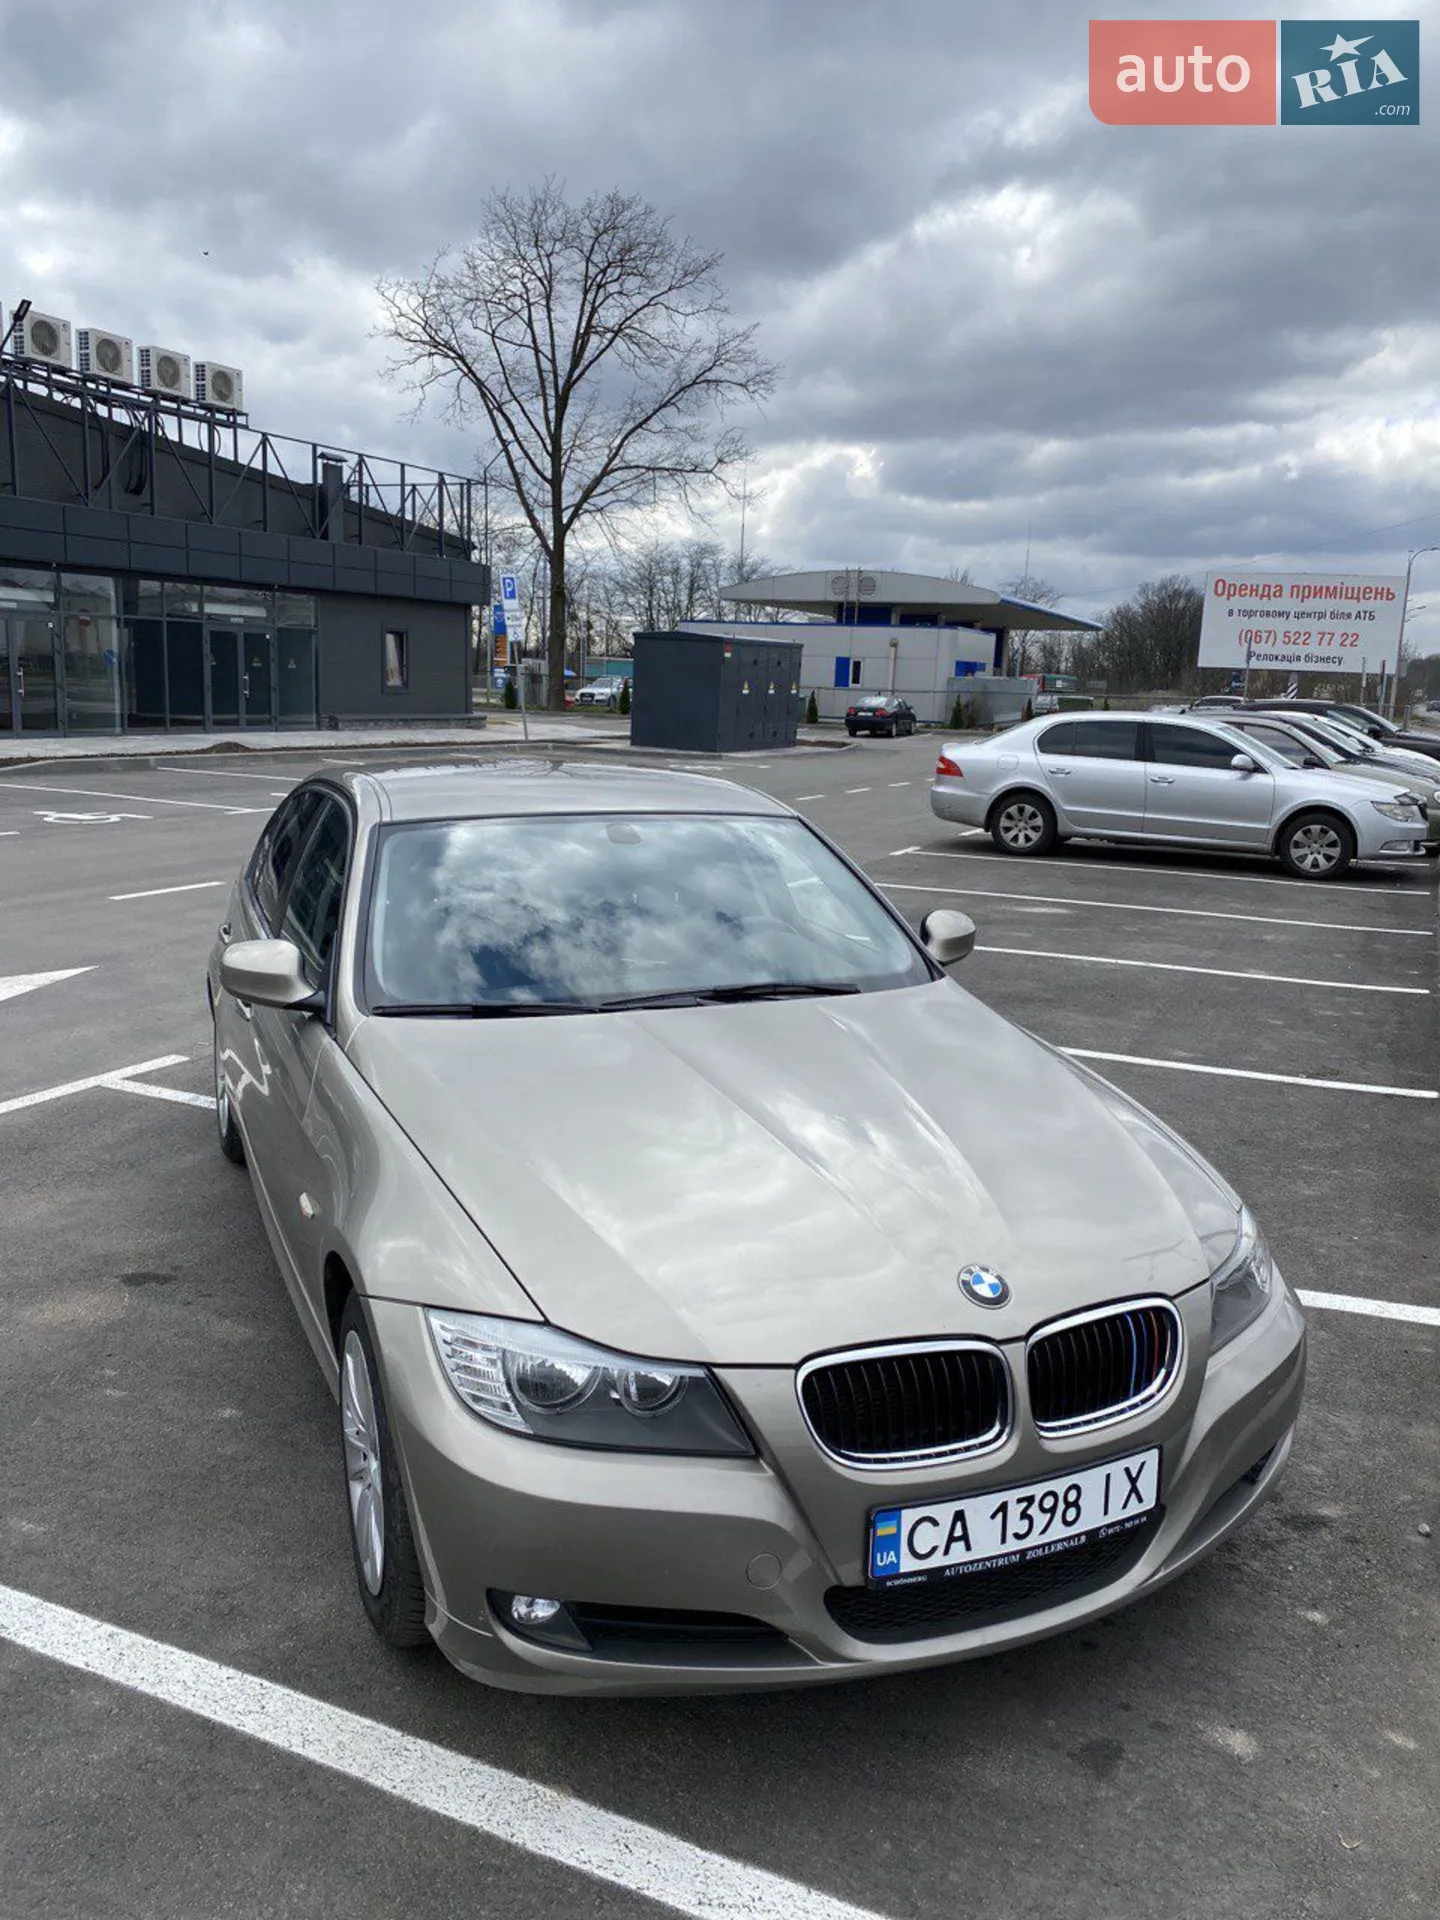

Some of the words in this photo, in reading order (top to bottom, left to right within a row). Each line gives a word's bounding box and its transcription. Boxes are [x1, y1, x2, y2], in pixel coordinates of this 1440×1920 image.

[1213, 578, 1284, 601] Оренда
[1289, 581, 1396, 604] приміщень
[1227, 608, 1234, 618] в
[1237, 608, 1291, 620] торговому
[1293, 609, 1327, 622] центрі
[1329, 609, 1353, 621] біля
[1354, 609, 1376, 622] АТБ
[1238, 628, 1278, 647] (067)
[1282, 630, 1312, 646] 522
[1317, 630, 1336, 647] 77
[1339, 632, 1360, 648] 22
[1248, 650, 1301, 665] Релокація
[1304, 651, 1344, 666] бізнесу
[906, 1508, 972, 1561] CA
[989, 1482, 1083, 1546] 1398
[1102, 1460, 1147, 1517] IX
[876, 1550, 898, 1567] UA
[943, 1553, 1020, 1578] AUTOZENTRUM
[1025, 1534, 1087, 1560] ZOLLERNALB
